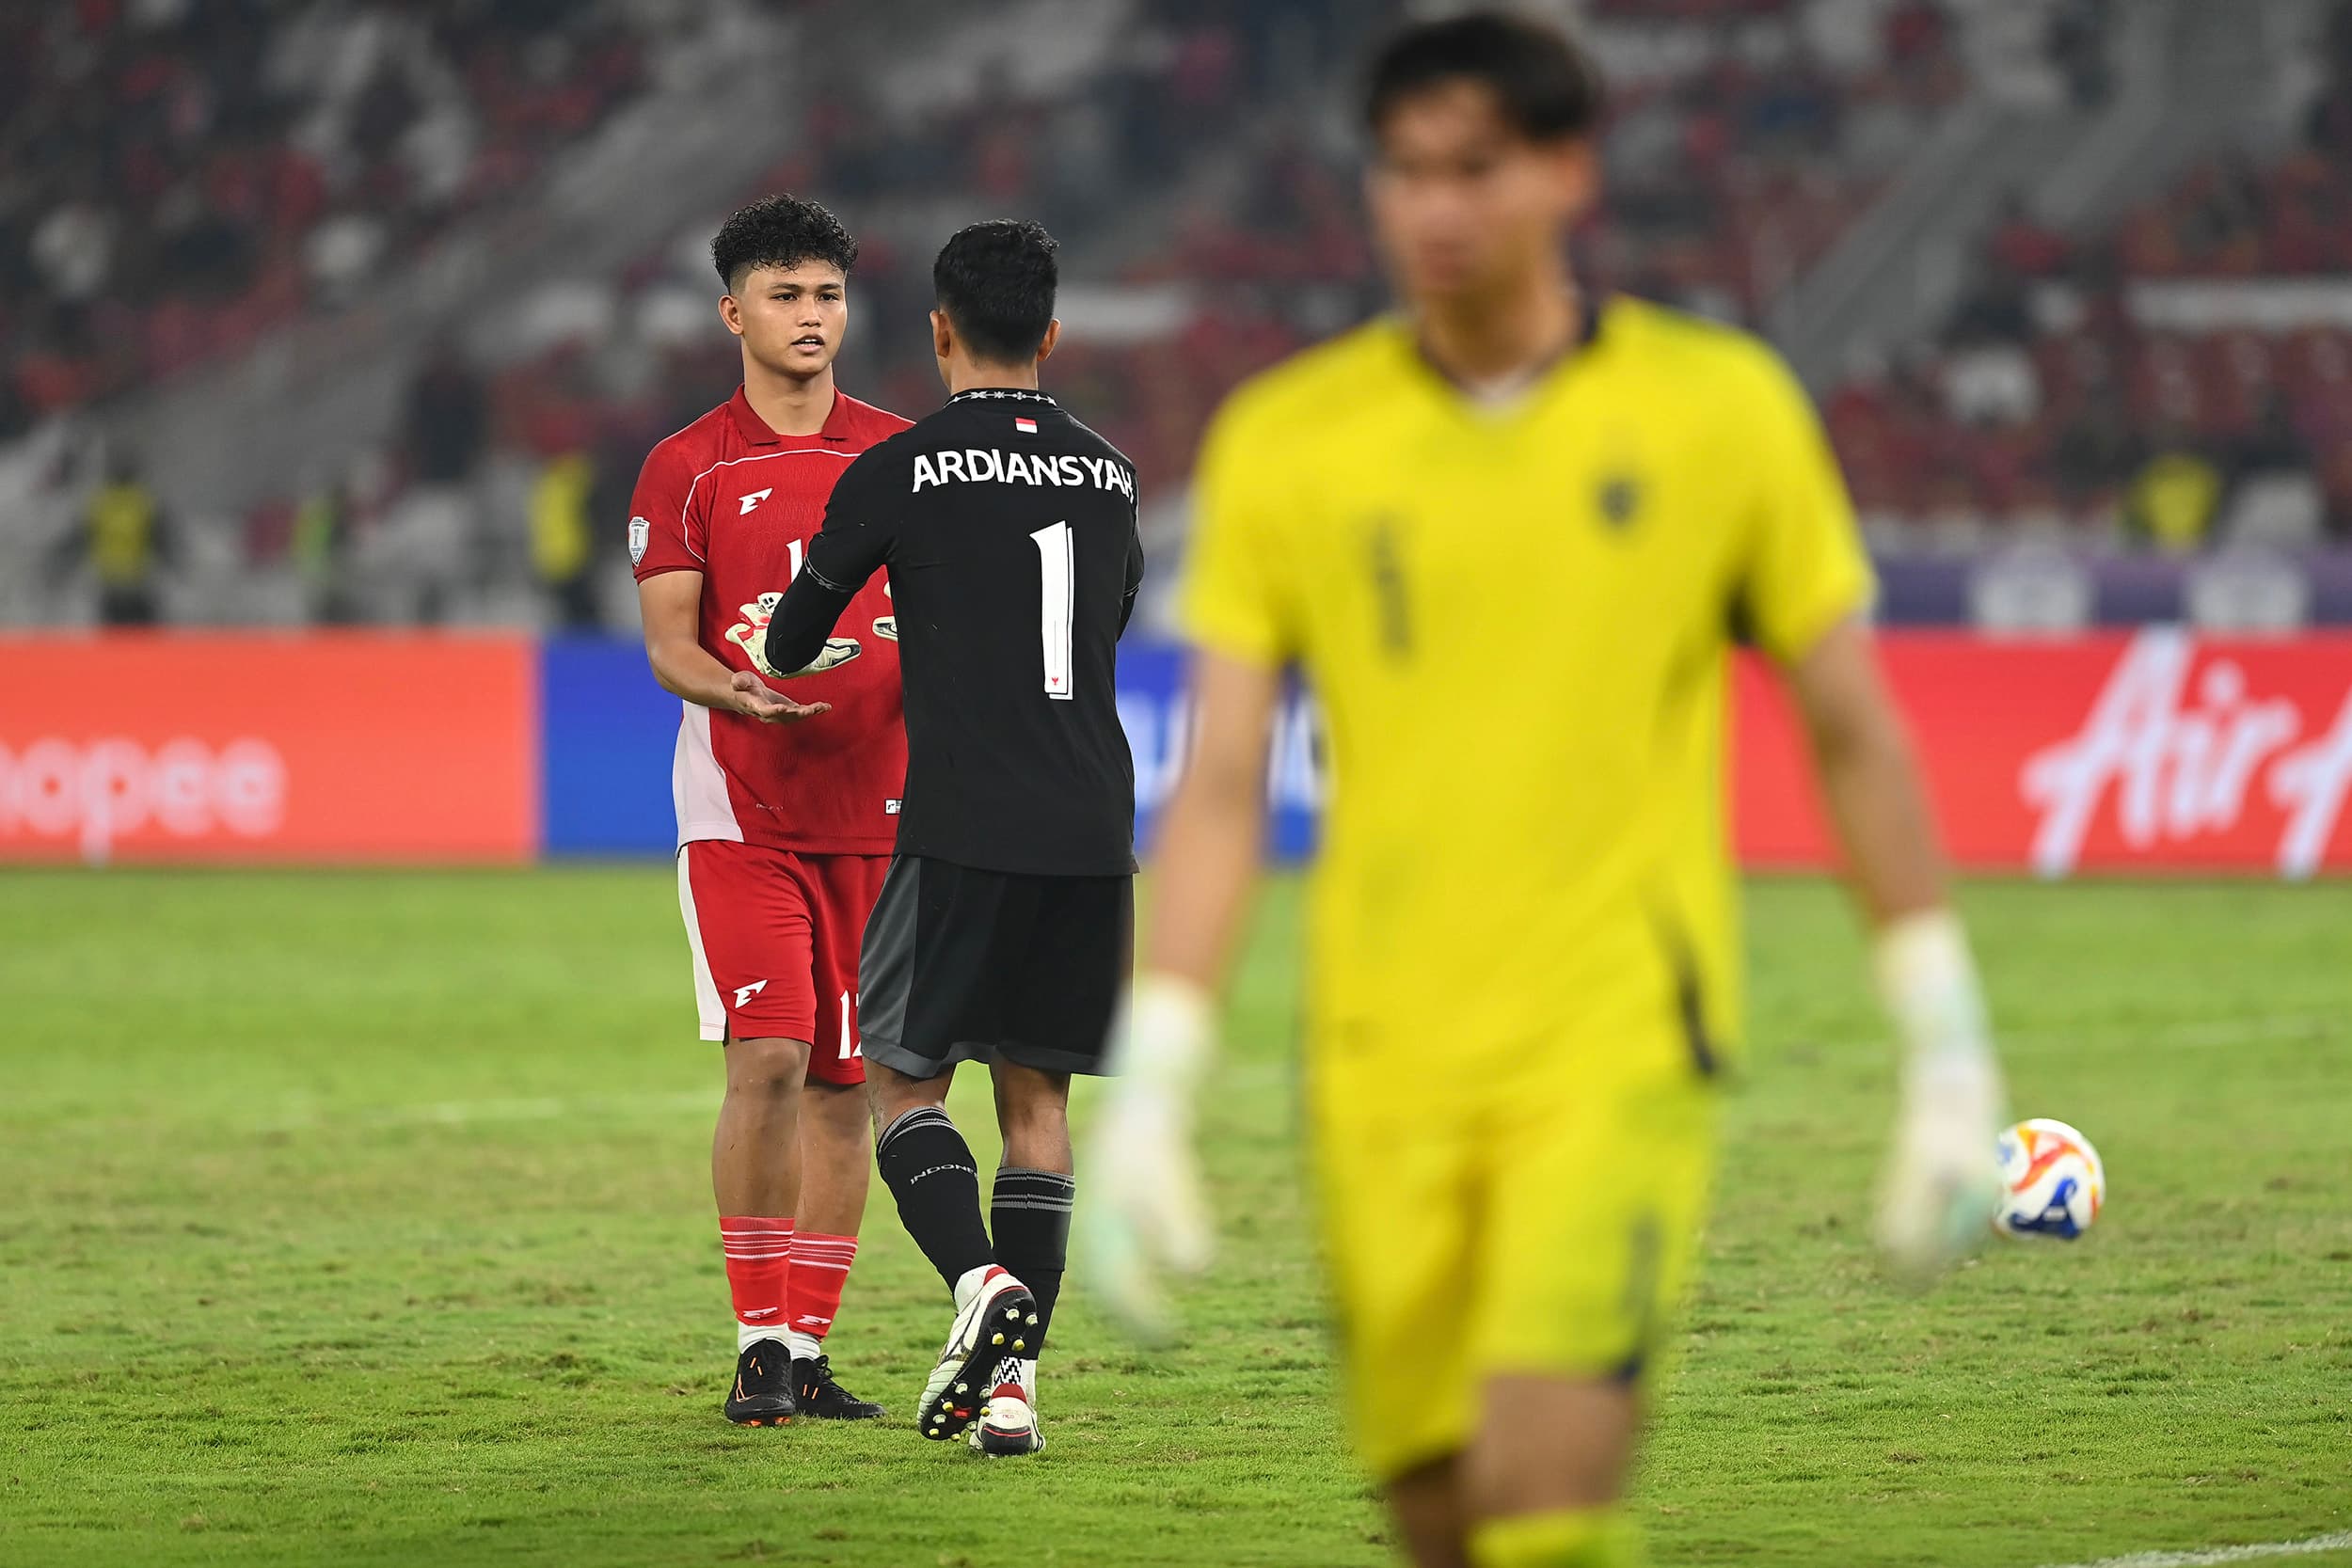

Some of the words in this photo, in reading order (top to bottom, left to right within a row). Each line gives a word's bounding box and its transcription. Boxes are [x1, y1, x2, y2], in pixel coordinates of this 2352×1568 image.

[912, 449, 1135, 504] ARDIANSYAH
[1029, 520, 1074, 701] 1
[838, 990, 863, 1059] 1
